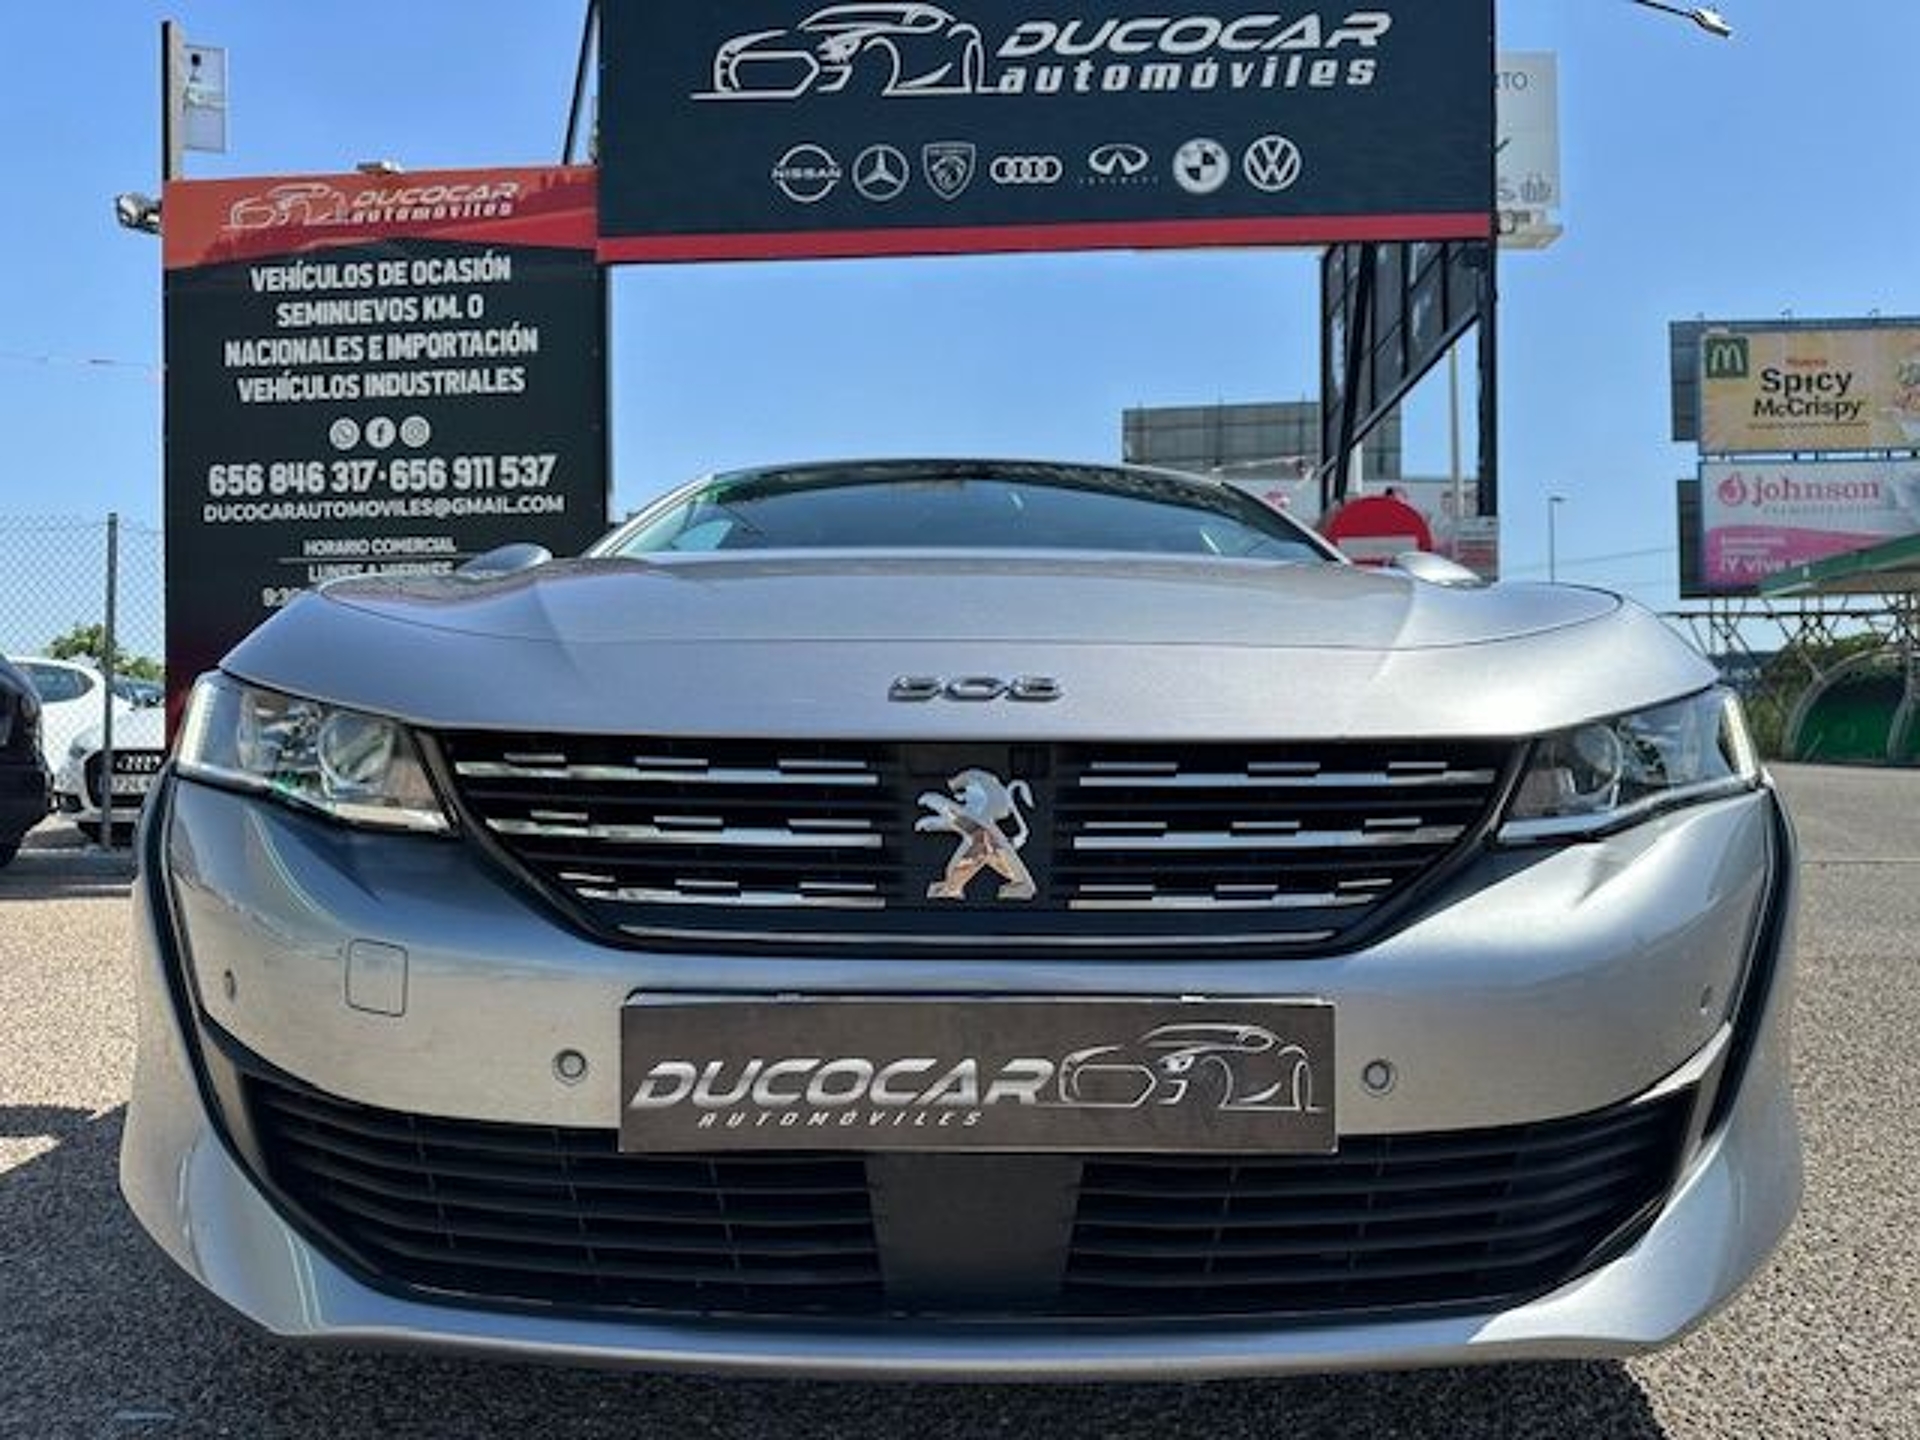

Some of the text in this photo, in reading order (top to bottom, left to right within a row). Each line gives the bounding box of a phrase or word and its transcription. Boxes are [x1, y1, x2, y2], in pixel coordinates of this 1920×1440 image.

[998, 12, 1391, 57] DUCOCAR
[1000, 53, 1377, 94] automóviles
[769, 168, 843, 182] NISSAN
[352, 182, 520, 208] DUCOCAR
[251, 250, 512, 292] VEHÍCULOS DE OCASIÓN
[277, 299, 418, 329] SEMINUEVOS
[422, 296, 463, 321] KM.
[224, 322, 539, 367] NACIONALES E IMPORTACIÓN
[237, 366, 527, 403] VEHÍCULOS INDUSTRIALES
[1760, 367, 1852, 398] Spicy
[1753, 395, 1863, 421] McCrispy
[208, 463, 264, 497] 656
[269, 461, 325, 495] 846
[452, 455, 495, 490] 911
[499, 453, 558, 488] 537
[1752, 475, 1879, 507] johnson
[202, 493, 565, 523] DUCOCARAUTOMOVILES@GMAIL.COM
[303, 536, 458, 557] HORARIO COMERCIAL
[628, 1057, 1057, 1110] DUCOCAR
[697, 1109, 984, 1129] AUTOMÓVILES
